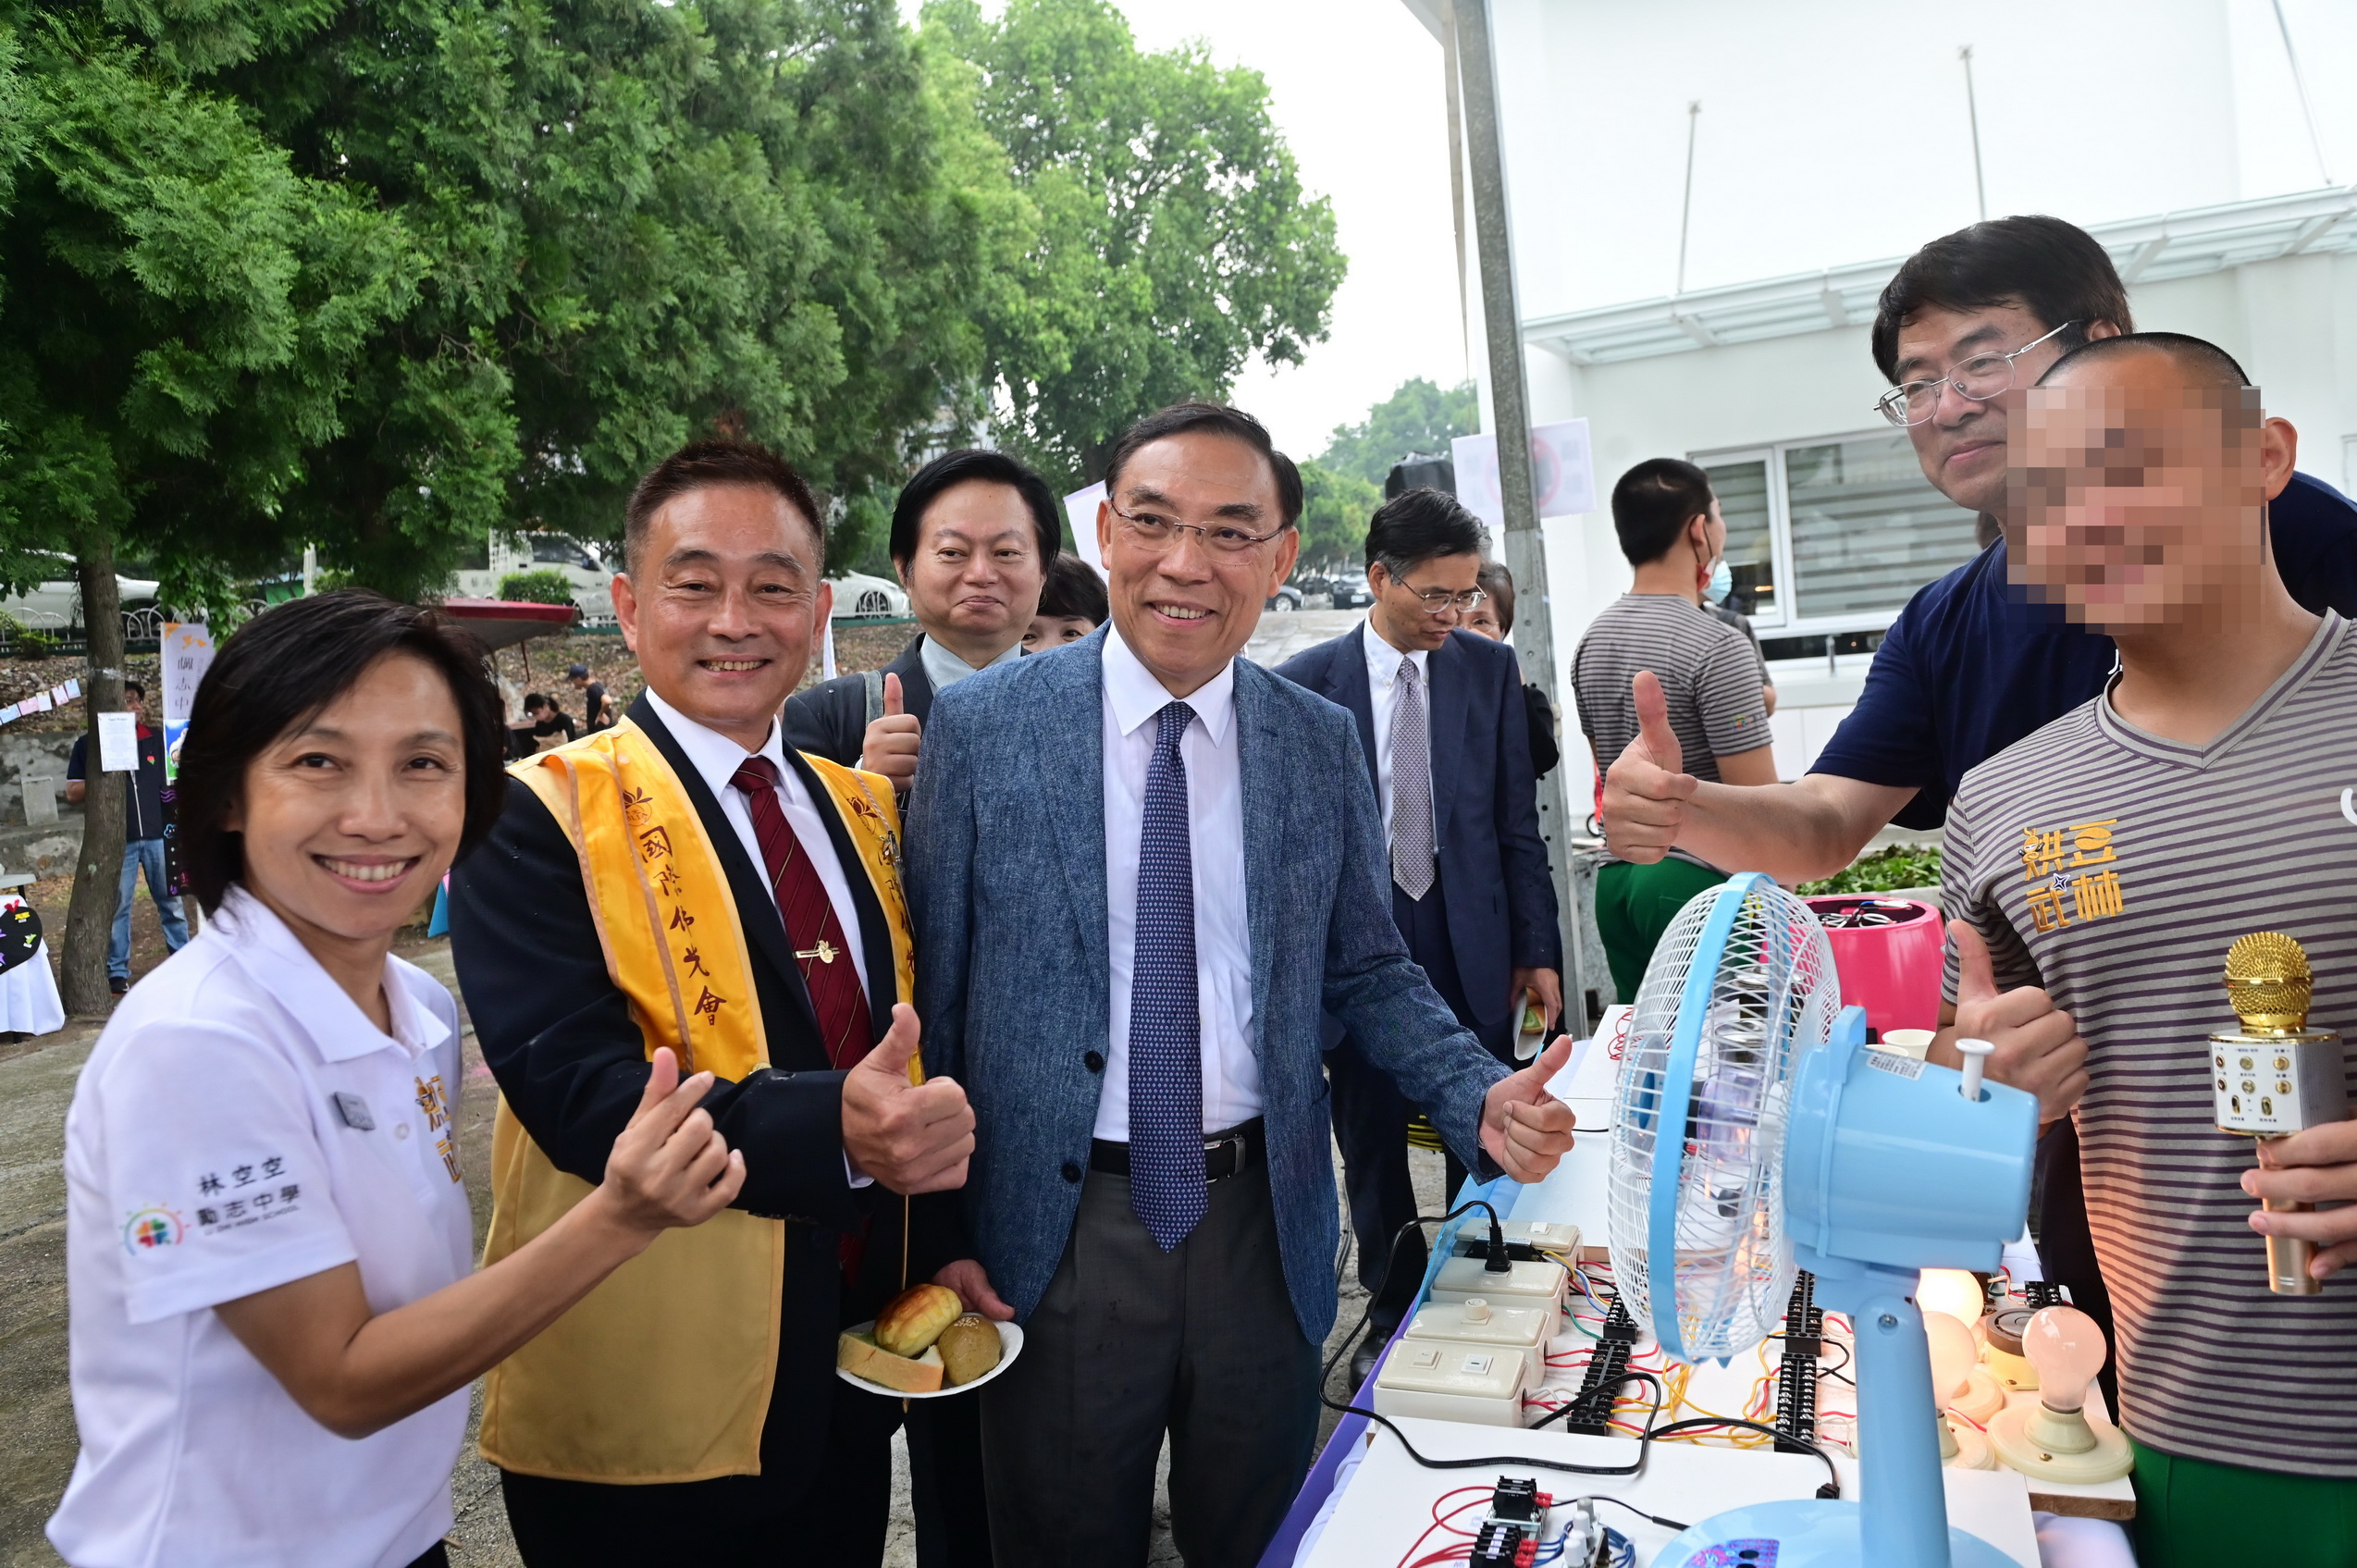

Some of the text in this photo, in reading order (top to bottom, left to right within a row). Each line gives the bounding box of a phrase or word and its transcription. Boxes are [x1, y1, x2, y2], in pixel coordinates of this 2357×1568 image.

[639, 825, 727, 1026] 國際佛光會
